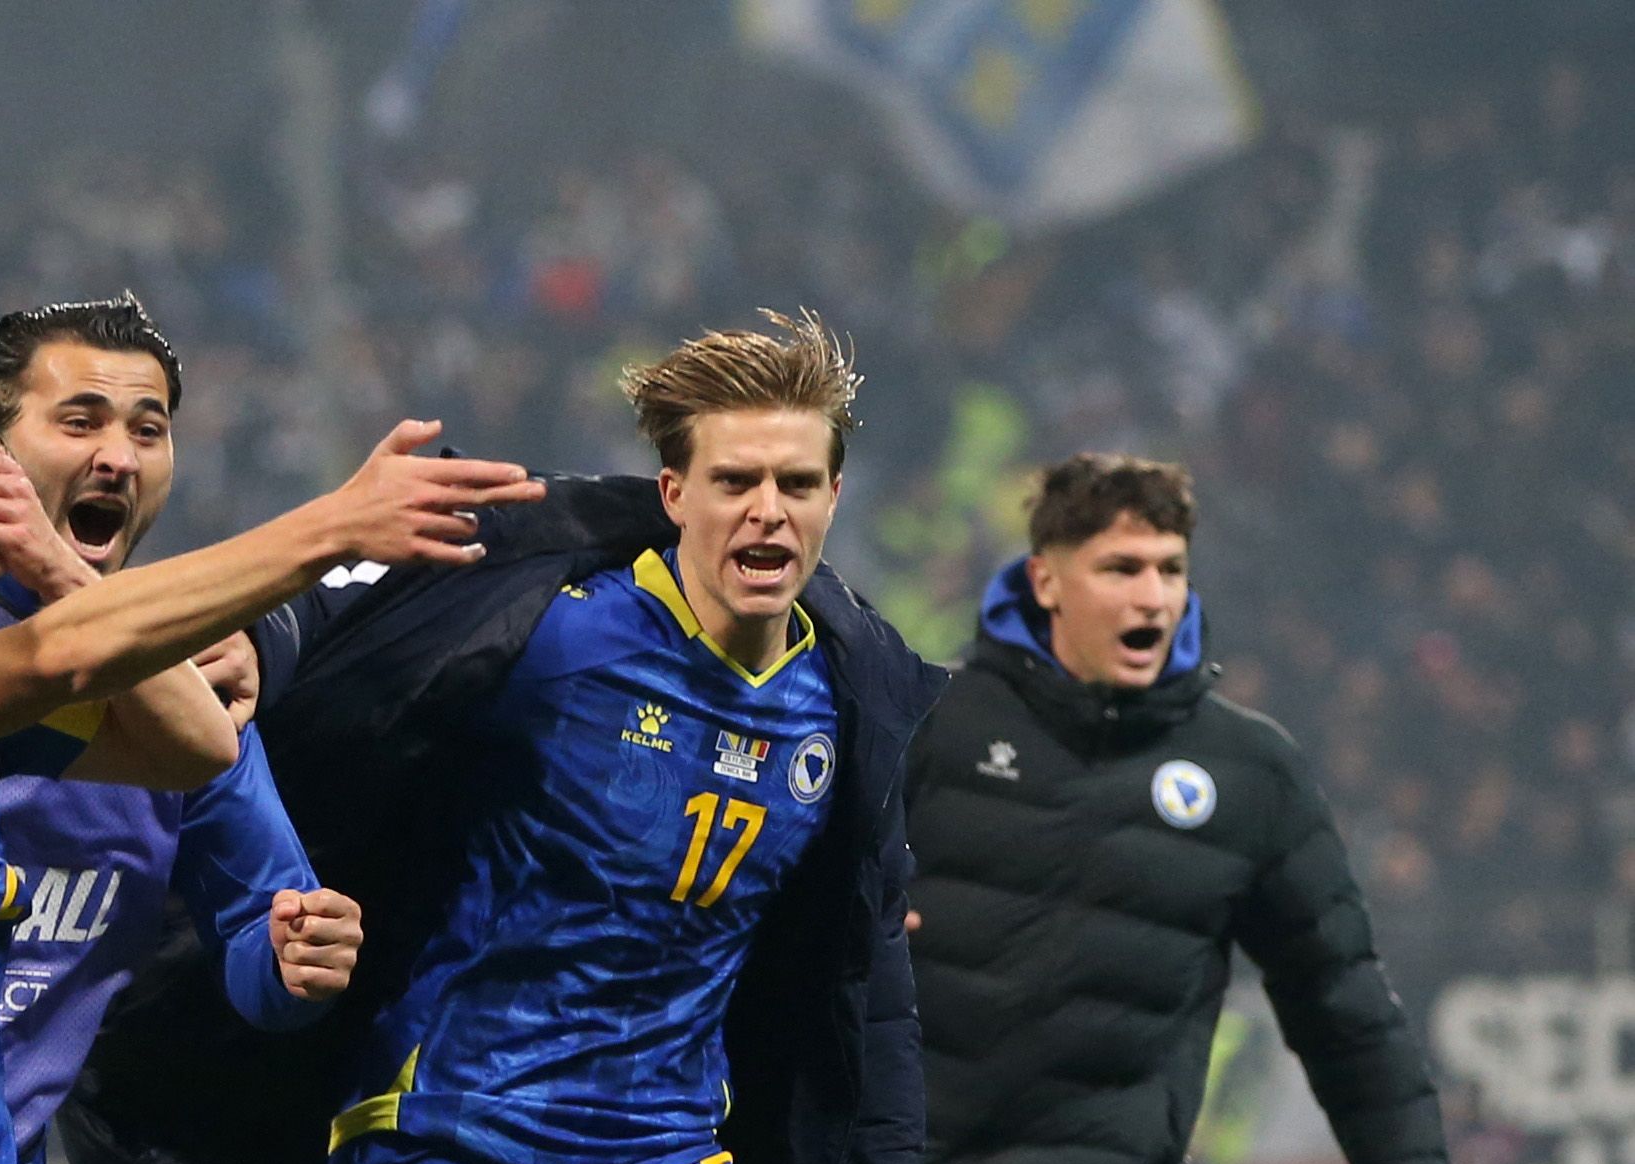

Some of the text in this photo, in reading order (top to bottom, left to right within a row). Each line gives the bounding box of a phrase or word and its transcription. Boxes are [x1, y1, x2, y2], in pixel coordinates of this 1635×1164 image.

[621, 729, 673, 752] KELME
[670, 791, 767, 908] 17
[13, 867, 123, 942] ALL
[0, 981, 48, 1012] CT
